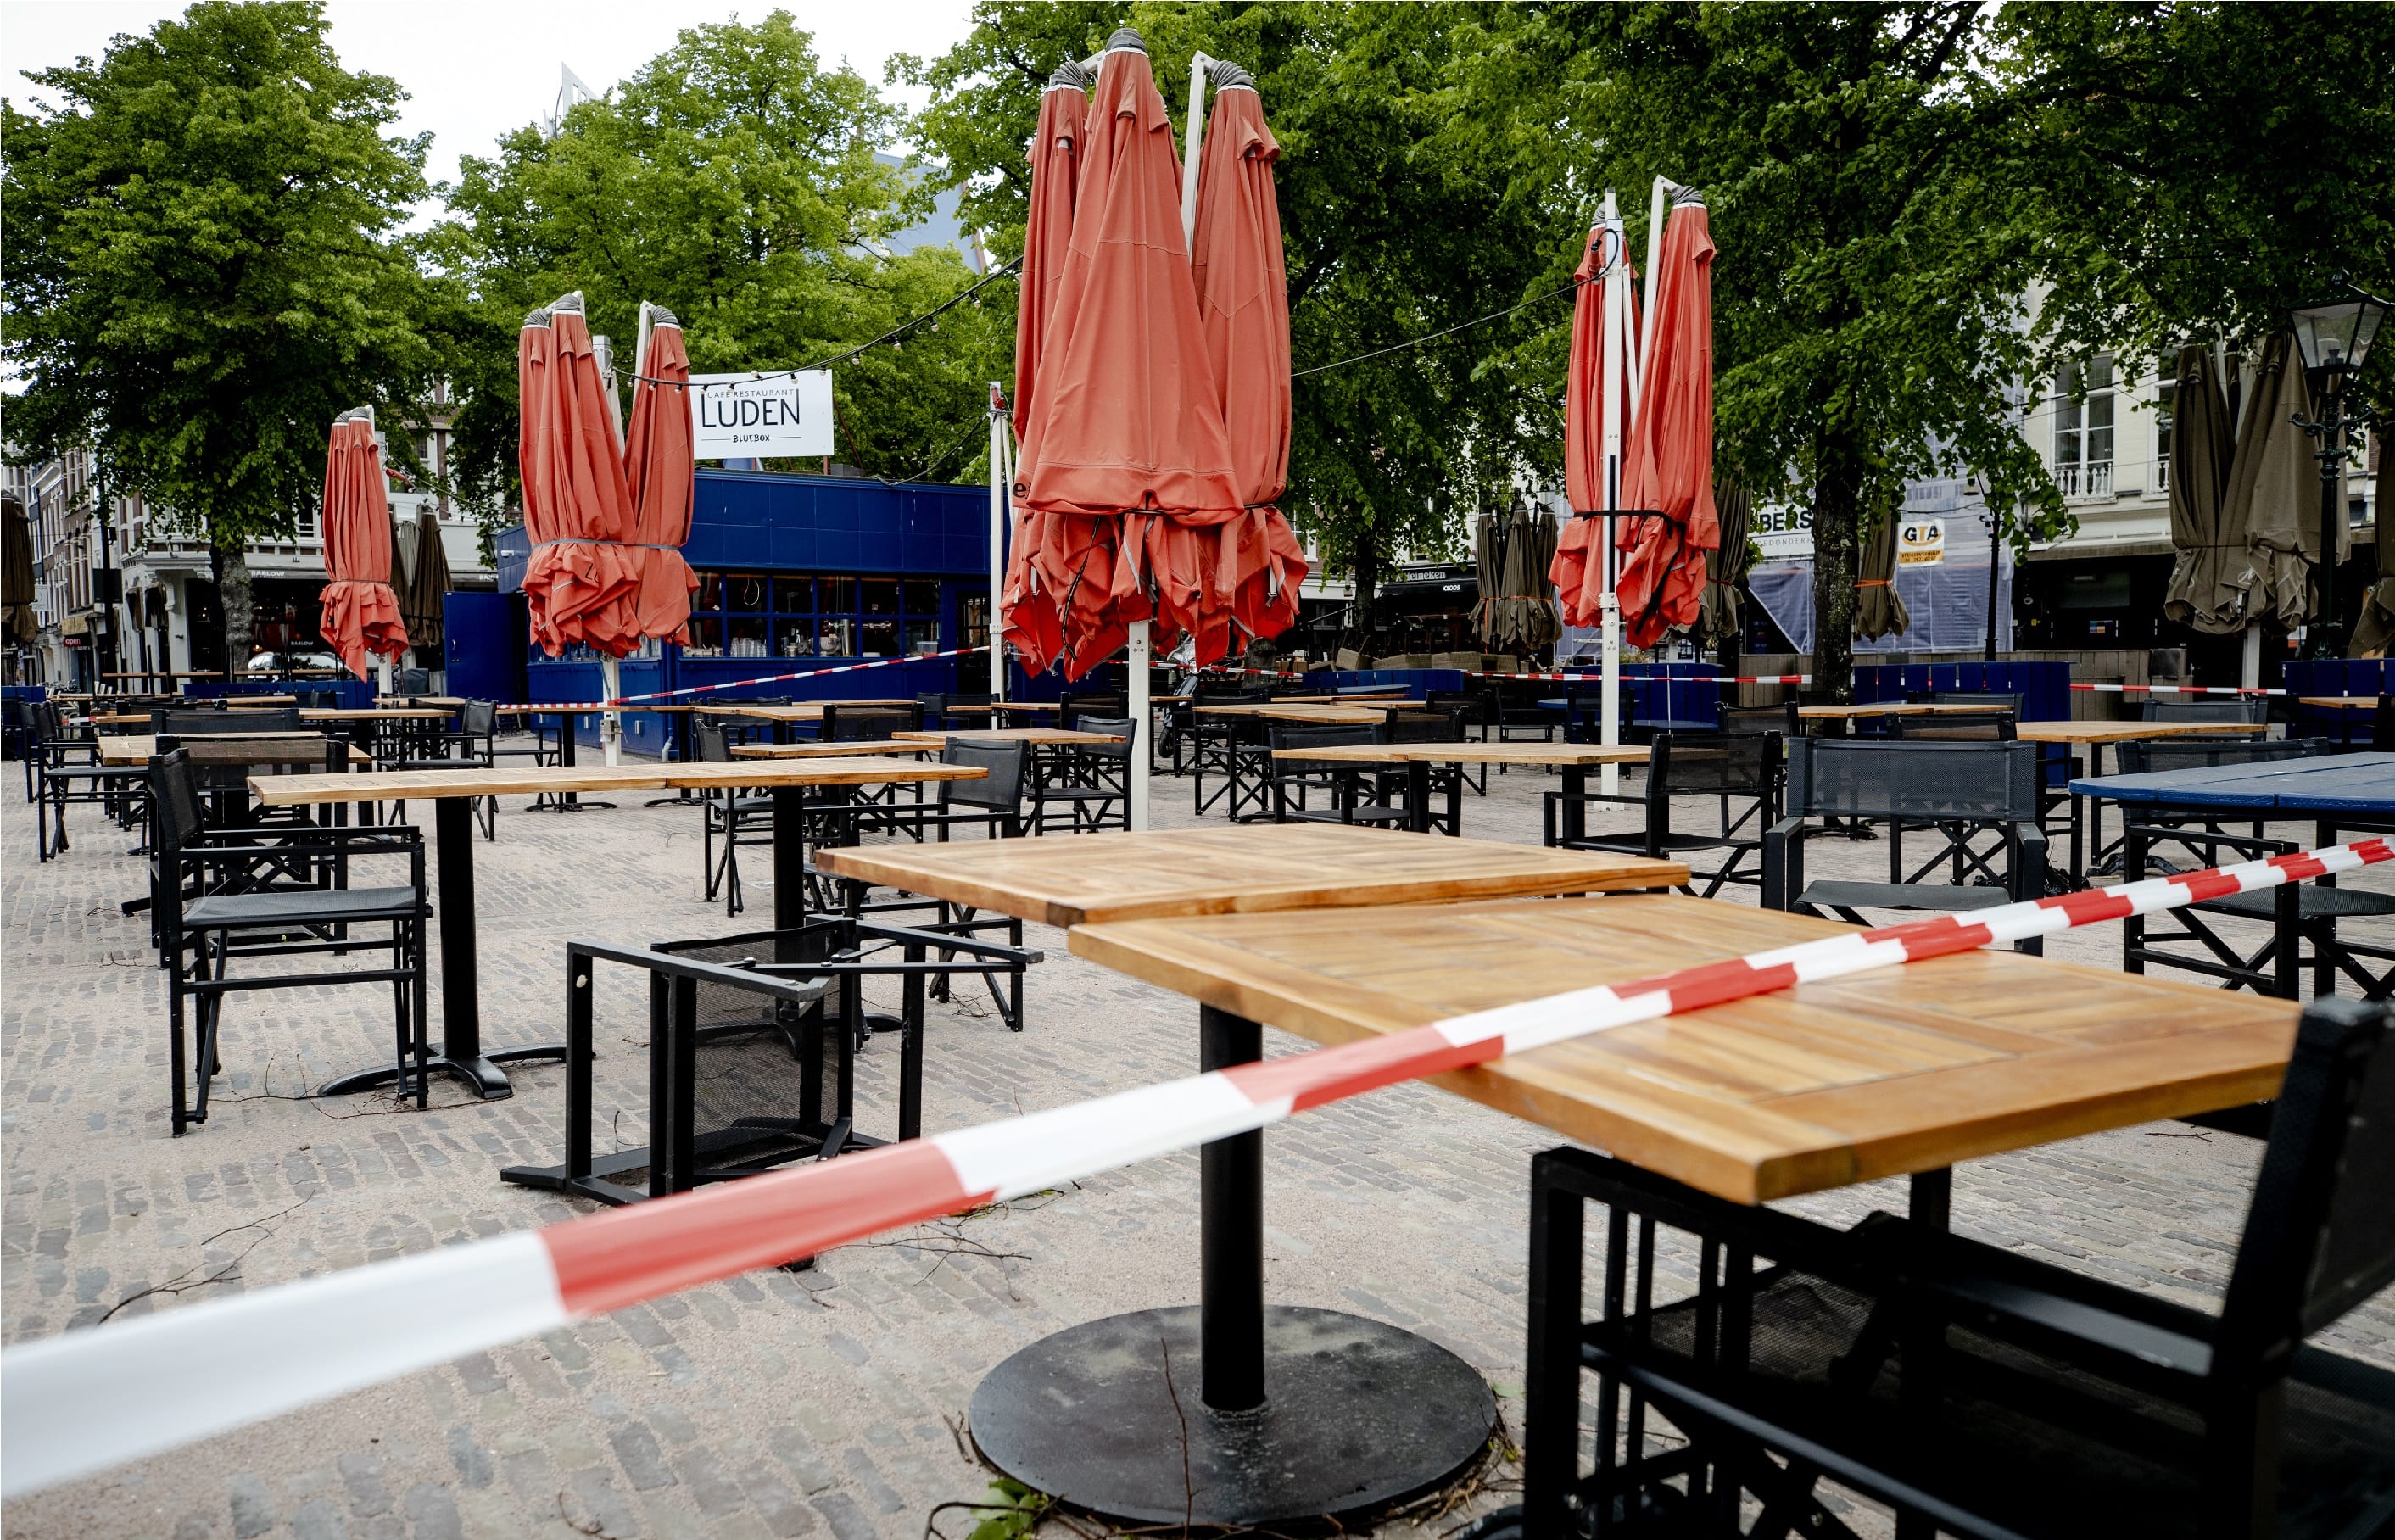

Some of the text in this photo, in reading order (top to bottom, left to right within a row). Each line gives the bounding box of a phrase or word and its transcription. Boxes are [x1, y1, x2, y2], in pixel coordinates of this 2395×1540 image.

[734, 389, 795, 398] RESTAURANT
[701, 388, 800, 427] LUDEN
[733, 434, 770, 443] BLUEBOX
[1904, 525, 1939, 542] GTA
